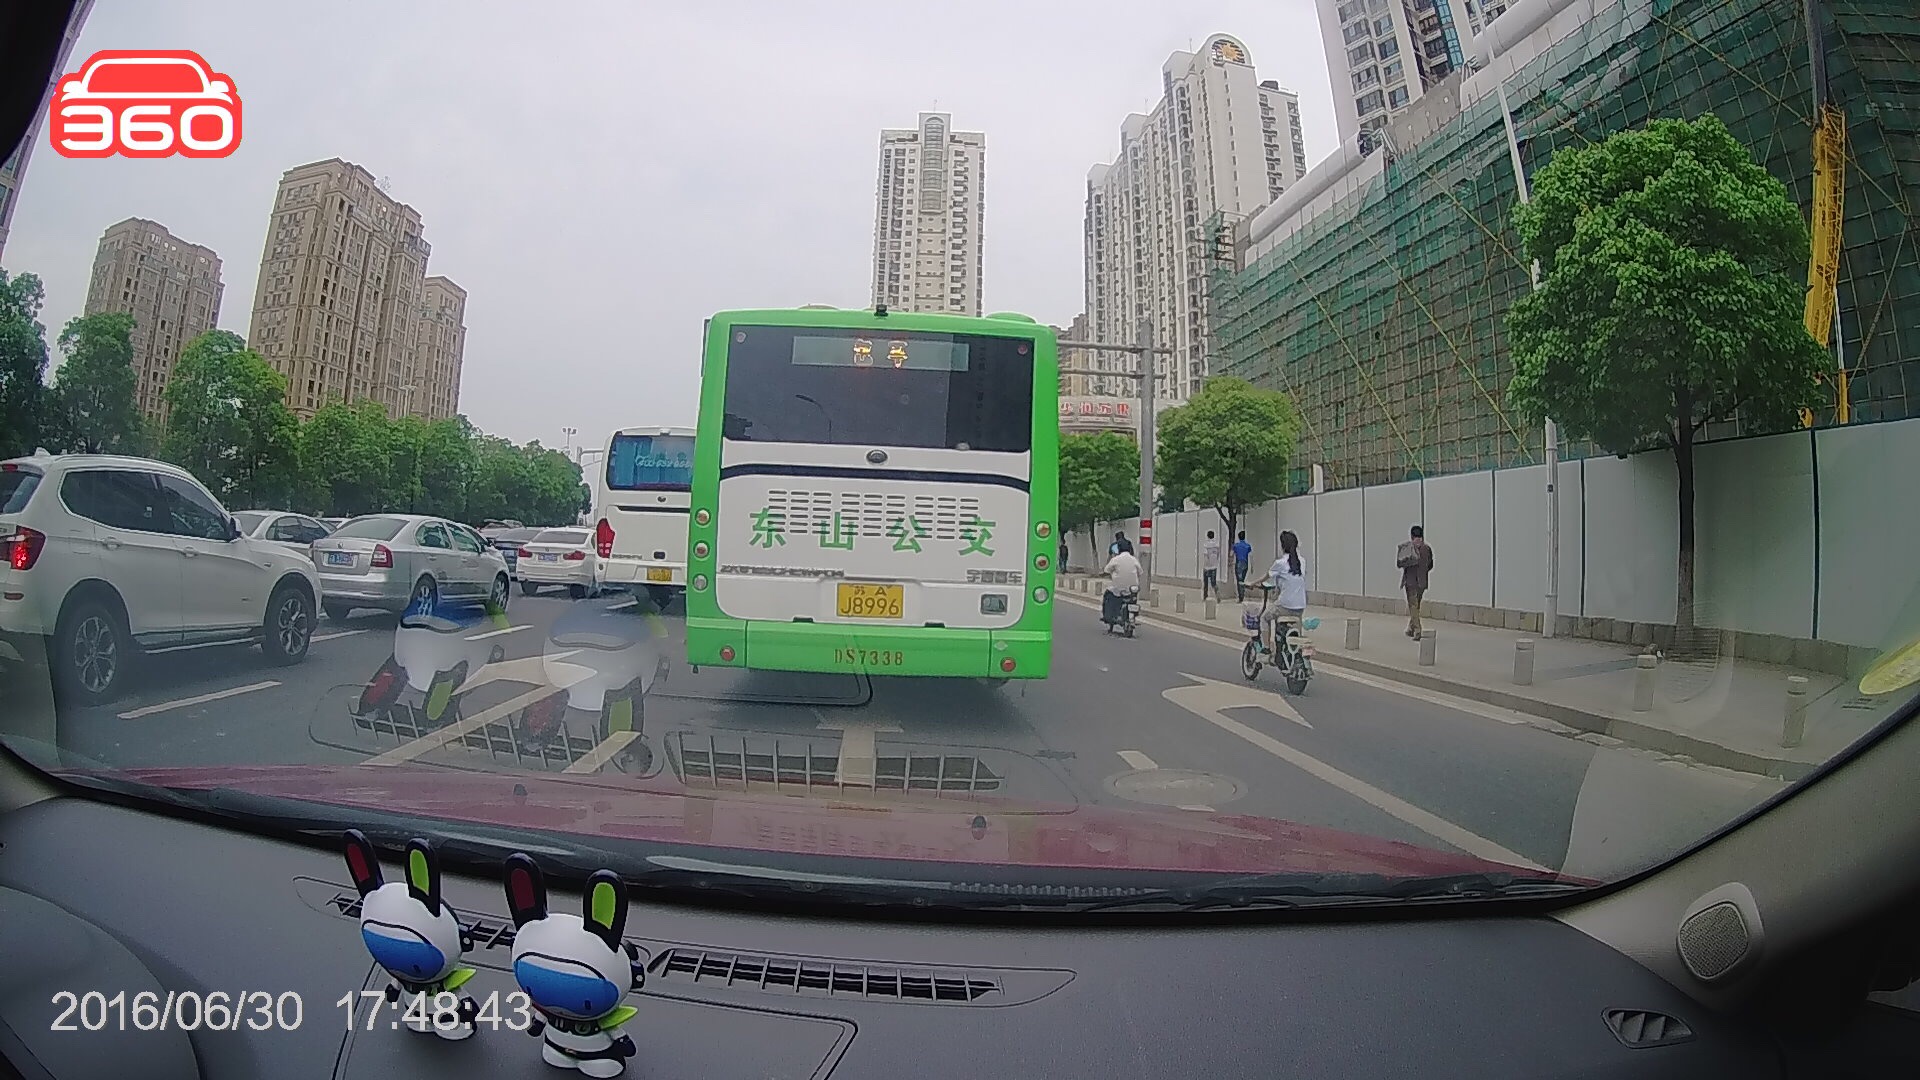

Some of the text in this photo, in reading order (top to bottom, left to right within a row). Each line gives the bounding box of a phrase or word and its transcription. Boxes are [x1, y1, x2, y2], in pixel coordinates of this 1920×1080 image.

[749, 506, 997, 558] 东山公交
[840, 597, 900, 616] J8996
[834, 648, 904, 666] DS7338
